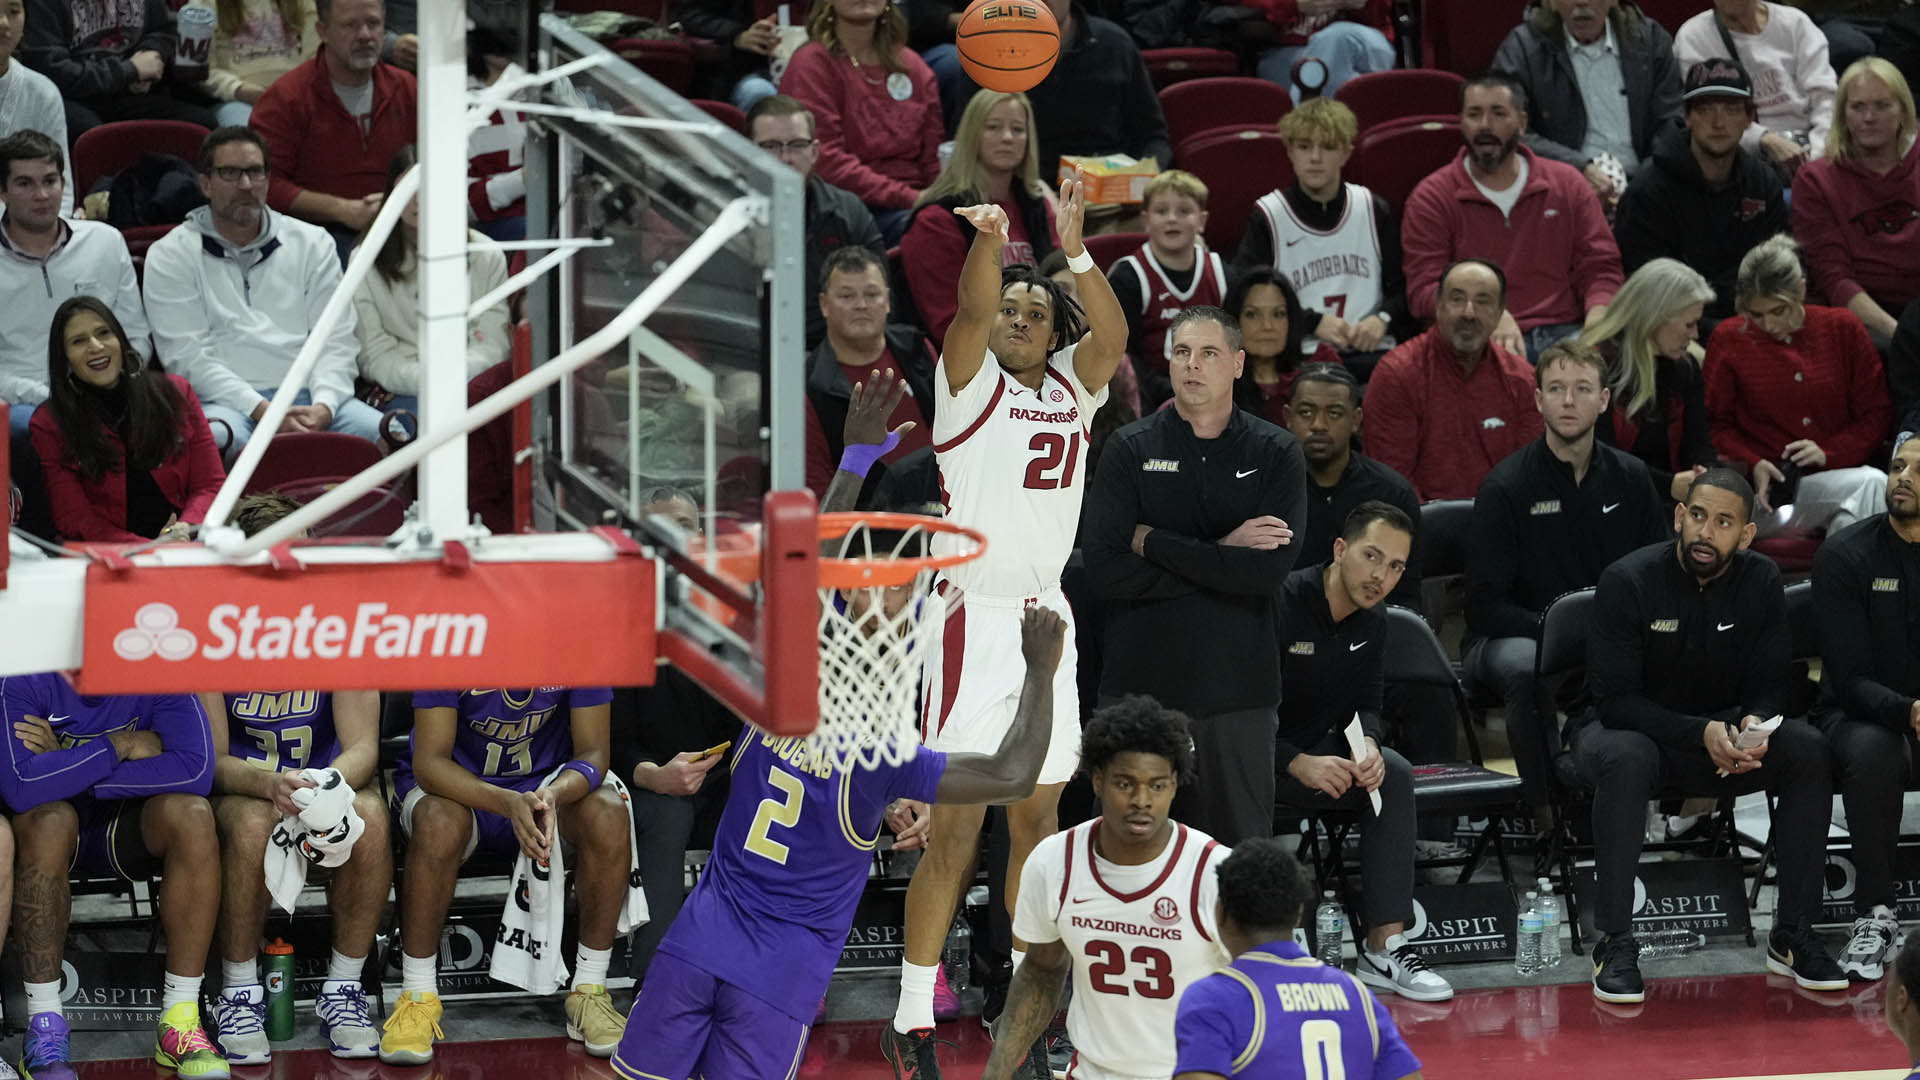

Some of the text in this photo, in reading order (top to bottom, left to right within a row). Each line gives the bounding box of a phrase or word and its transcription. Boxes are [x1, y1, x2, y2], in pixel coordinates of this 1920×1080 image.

[983, 5, 1037, 20] ELITE
[1323, 293, 1347, 318] 7
[1023, 431, 1080, 490] 21
[1143, 459, 1180, 473] JMU
[1530, 500, 1561, 515] JMU
[1871, 577, 1899, 592] JMU
[1650, 619, 1679, 632] JMU
[236, 689, 314, 718] JMU
[245, 726, 313, 773] 33
[482, 739, 533, 776] 13
[744, 765, 805, 865] 2
[1071, 915, 1182, 941] RAZORBACKS
[1663, 918, 1729, 931] LAWYERS
[1444, 939, 1507, 953] LAWYERS
[1084, 939, 1175, 1000] 23
[1275, 982, 1350, 1012] BROWN
[93, 1012, 161, 1022] LAWYERS
[1300, 1018, 1346, 1080] 0
